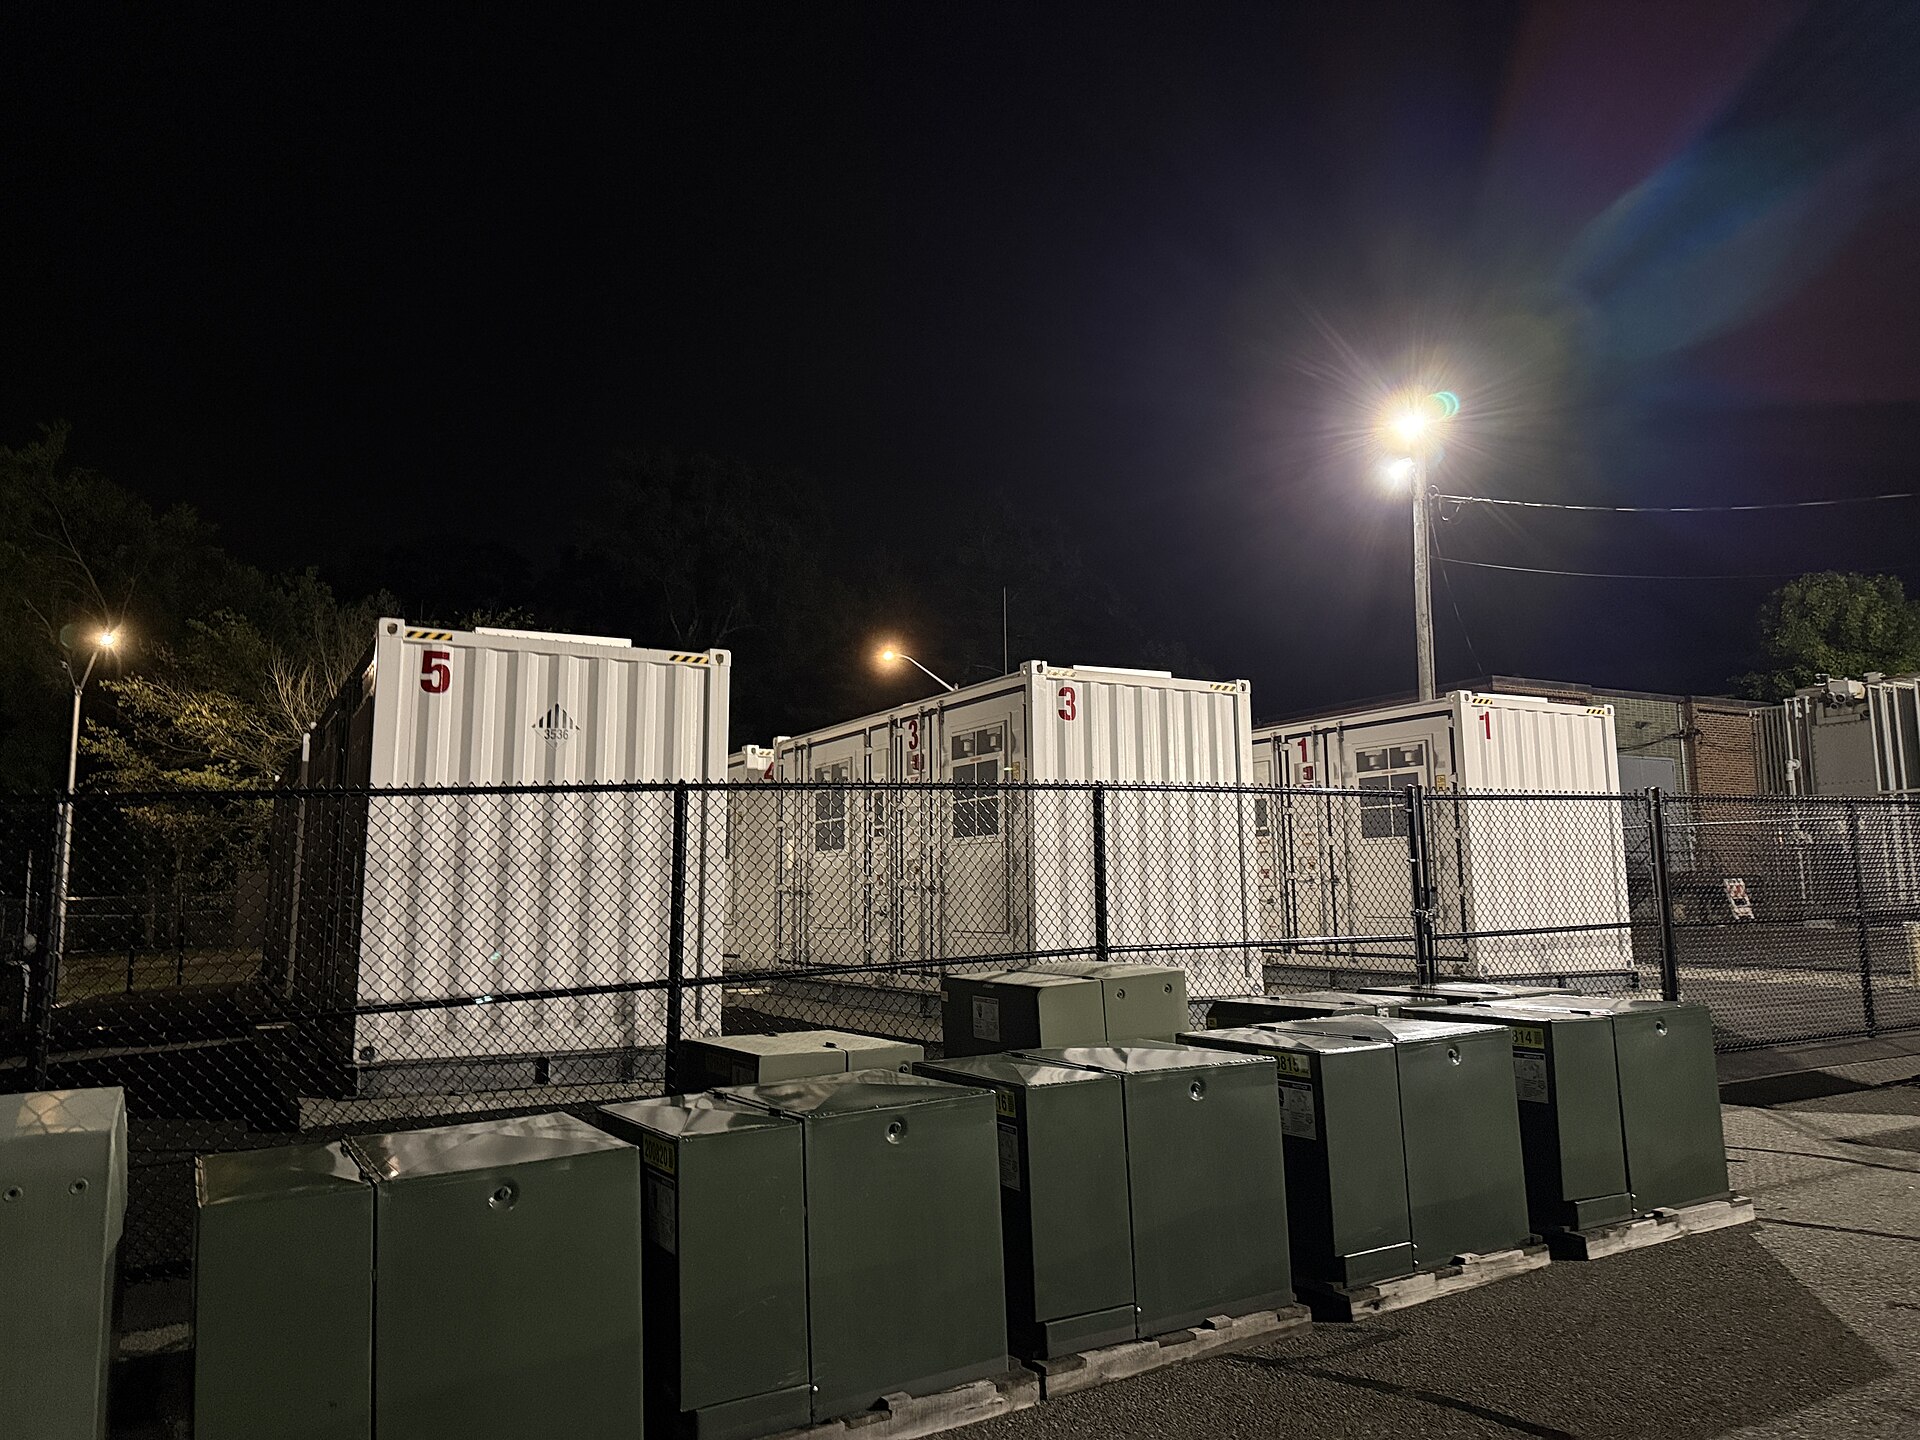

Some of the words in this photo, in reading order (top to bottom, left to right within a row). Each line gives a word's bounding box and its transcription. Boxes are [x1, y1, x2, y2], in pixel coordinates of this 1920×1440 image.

[420, 650, 450, 693] 5
[1058, 687, 1076, 720] 3
[544, 728, 569, 740] 3536
[908, 720, 919, 750] 3
[1479, 711, 1490, 739] 1
[1297, 737, 1308, 763] 1
[763, 761, 775, 781] 4
